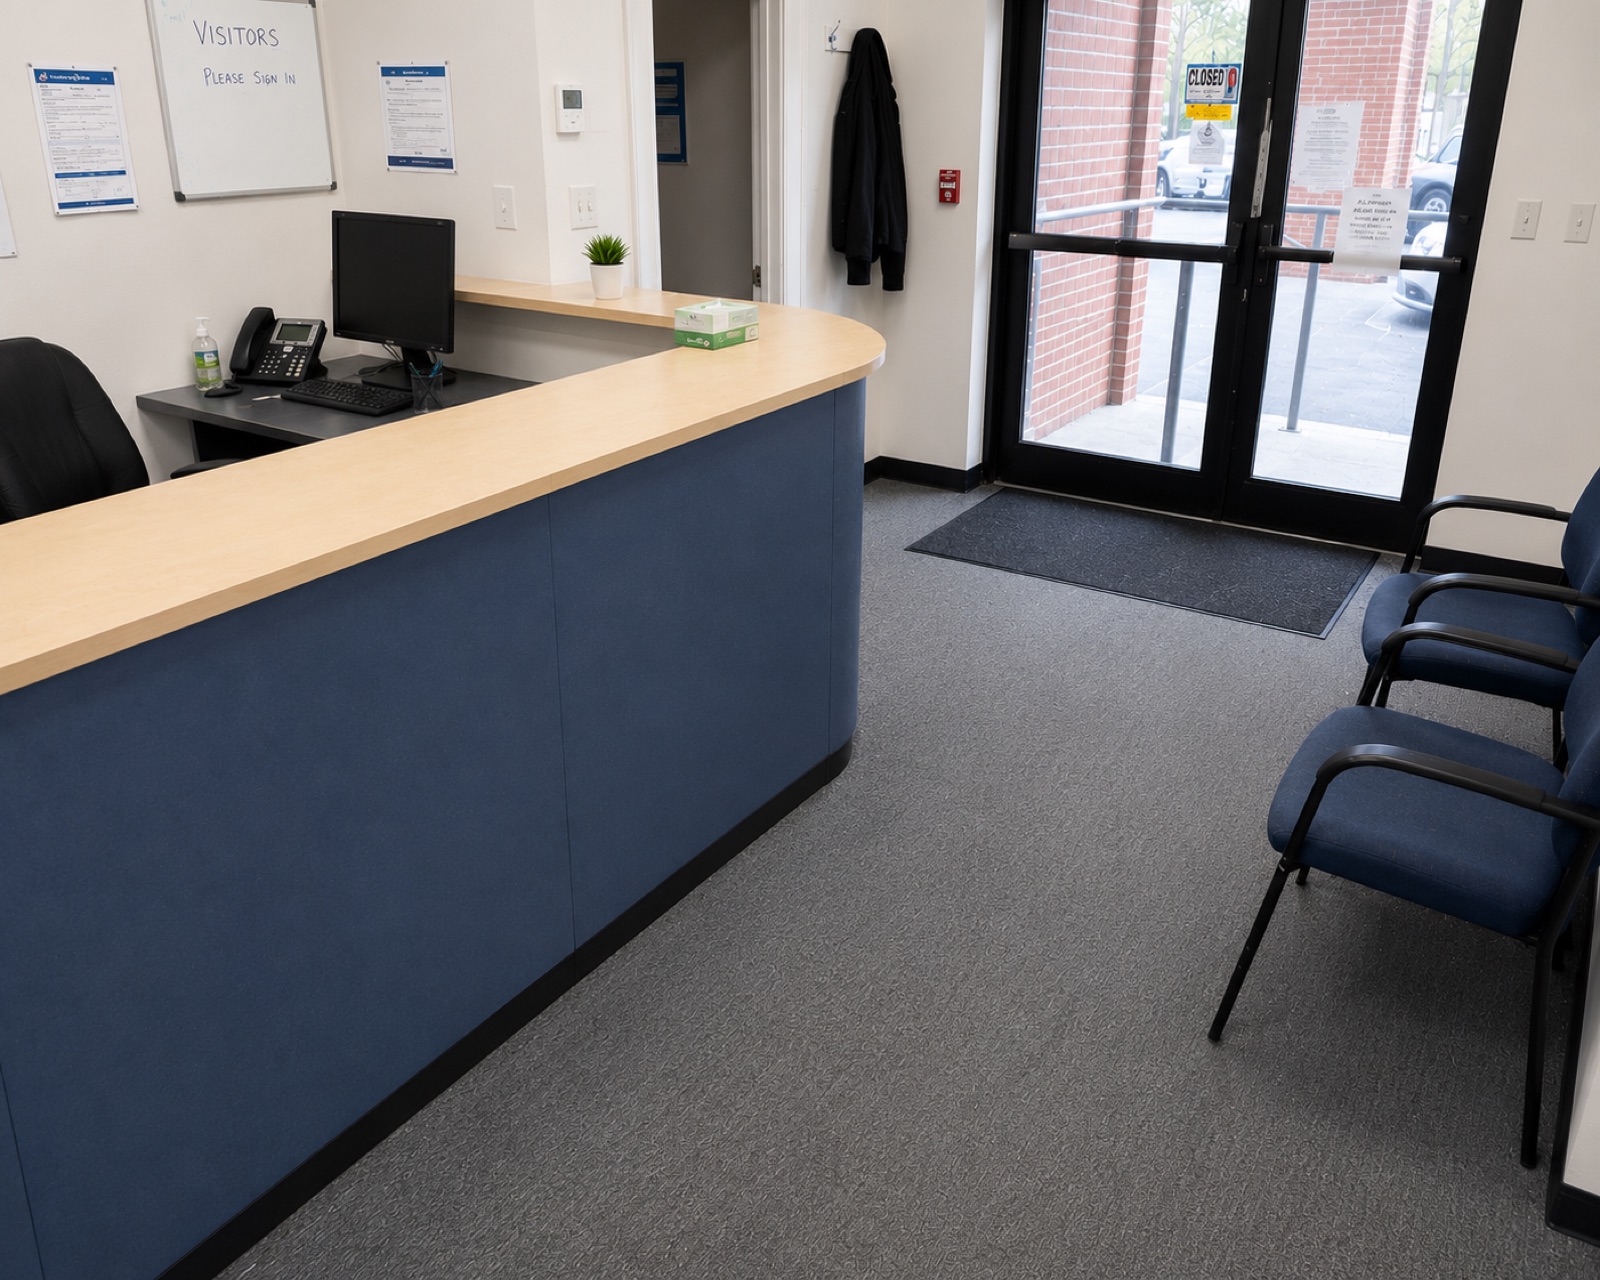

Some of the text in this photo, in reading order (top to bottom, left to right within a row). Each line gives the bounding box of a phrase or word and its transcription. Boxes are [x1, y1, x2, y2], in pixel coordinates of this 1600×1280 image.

[193, 20, 279, 47] VISITORS
[203, 67, 296, 87] PLEASE SIGN IN
[1188, 68, 1225, 86] CLOSED
